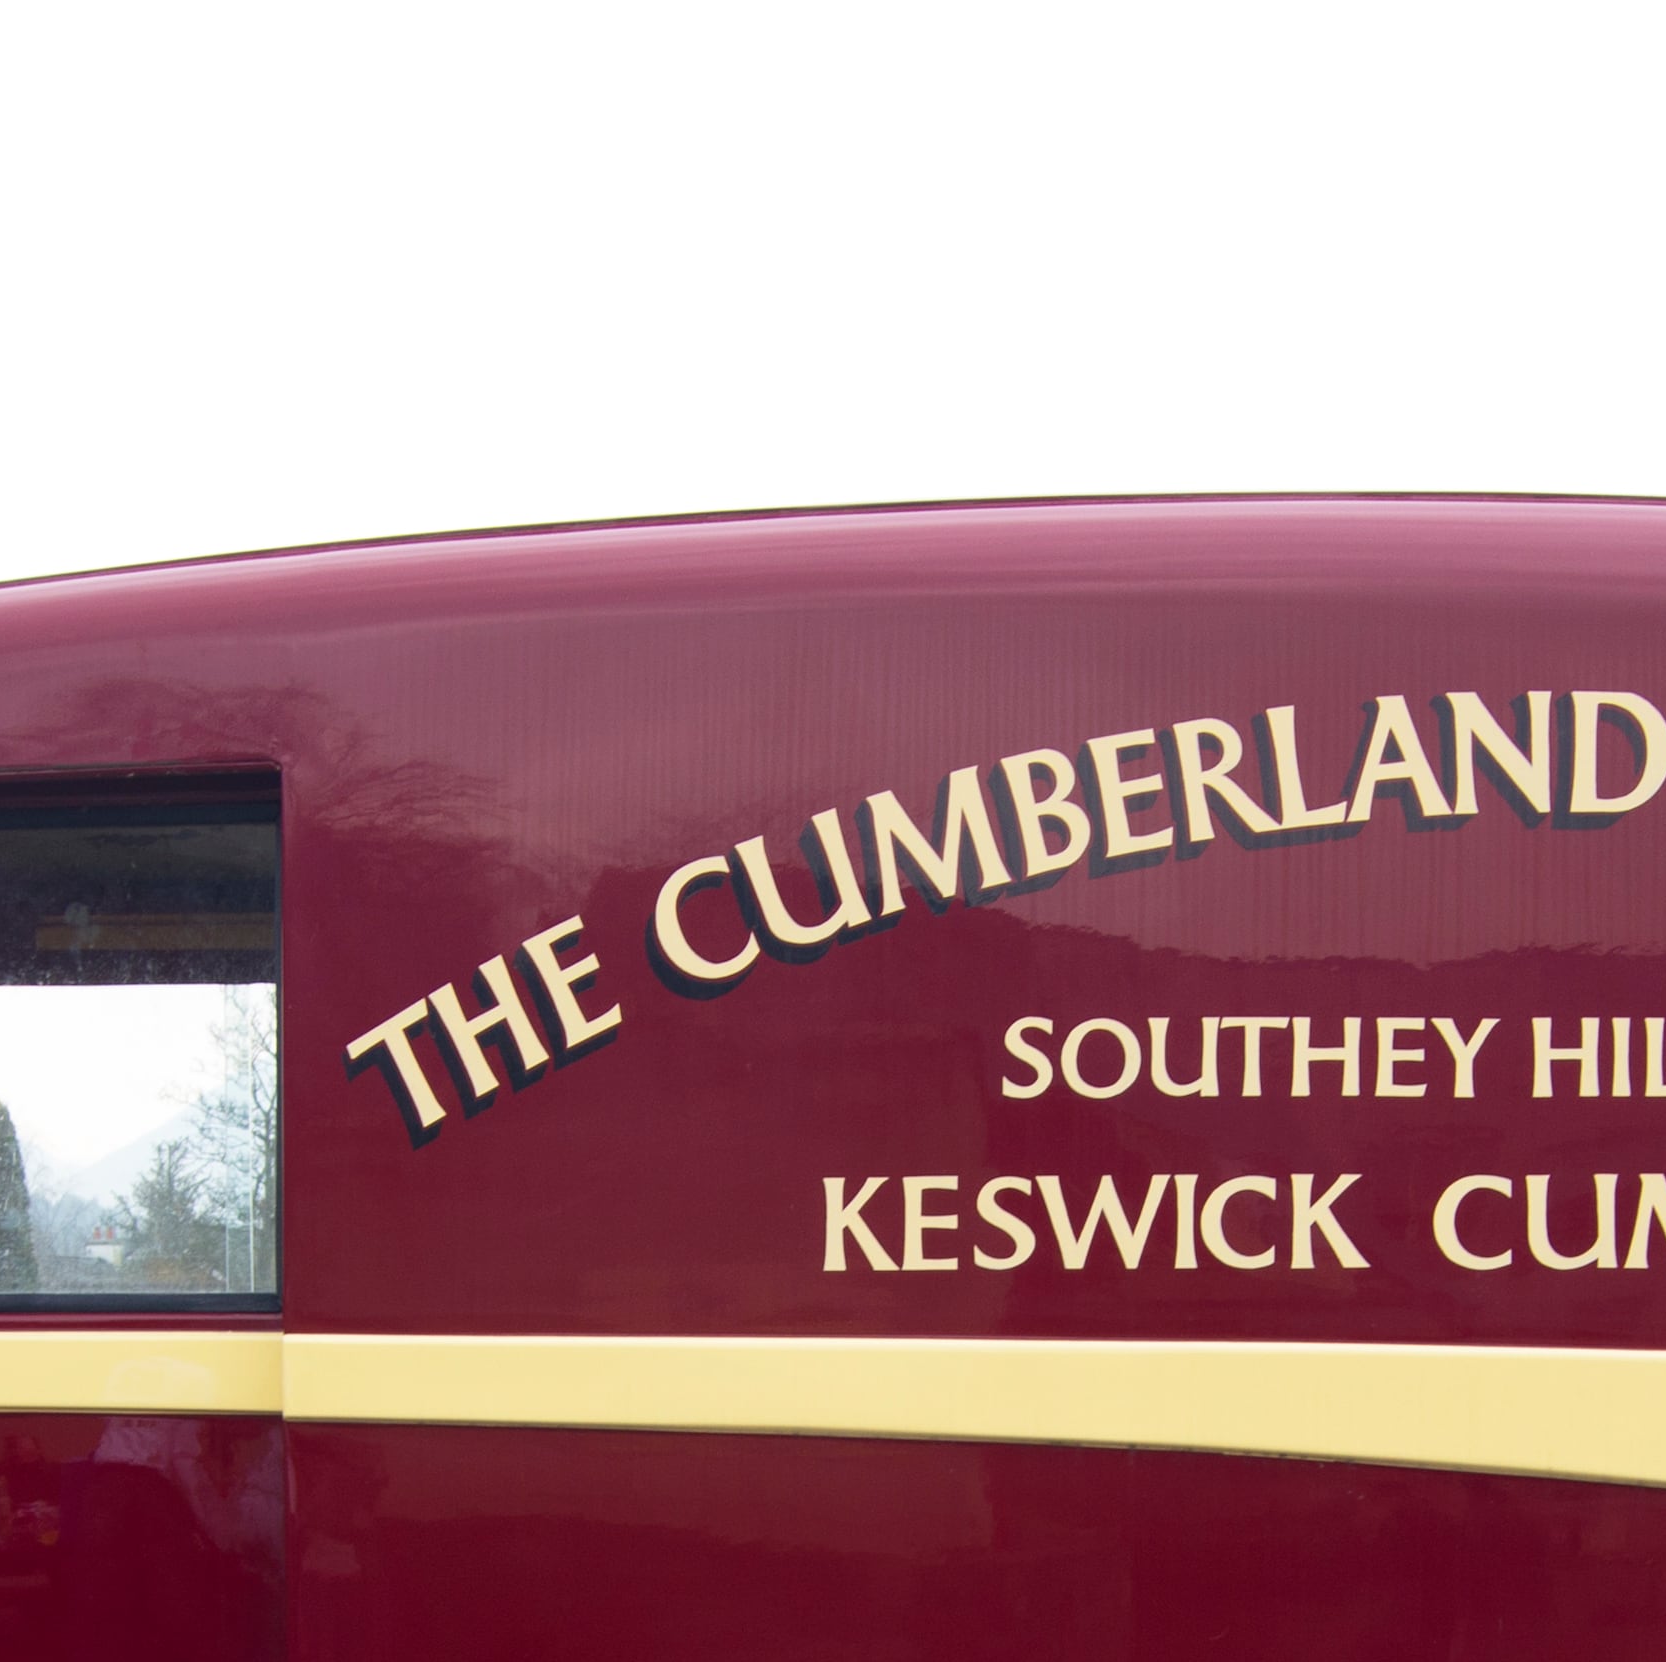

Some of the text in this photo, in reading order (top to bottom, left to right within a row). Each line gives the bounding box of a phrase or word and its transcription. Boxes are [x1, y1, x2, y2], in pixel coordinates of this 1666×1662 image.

[345, 914, 623, 1129] THE
[1001, 1015, 1501, 1100] SOUTHEY
[822, 1172, 1371, 1273] KESWICK
